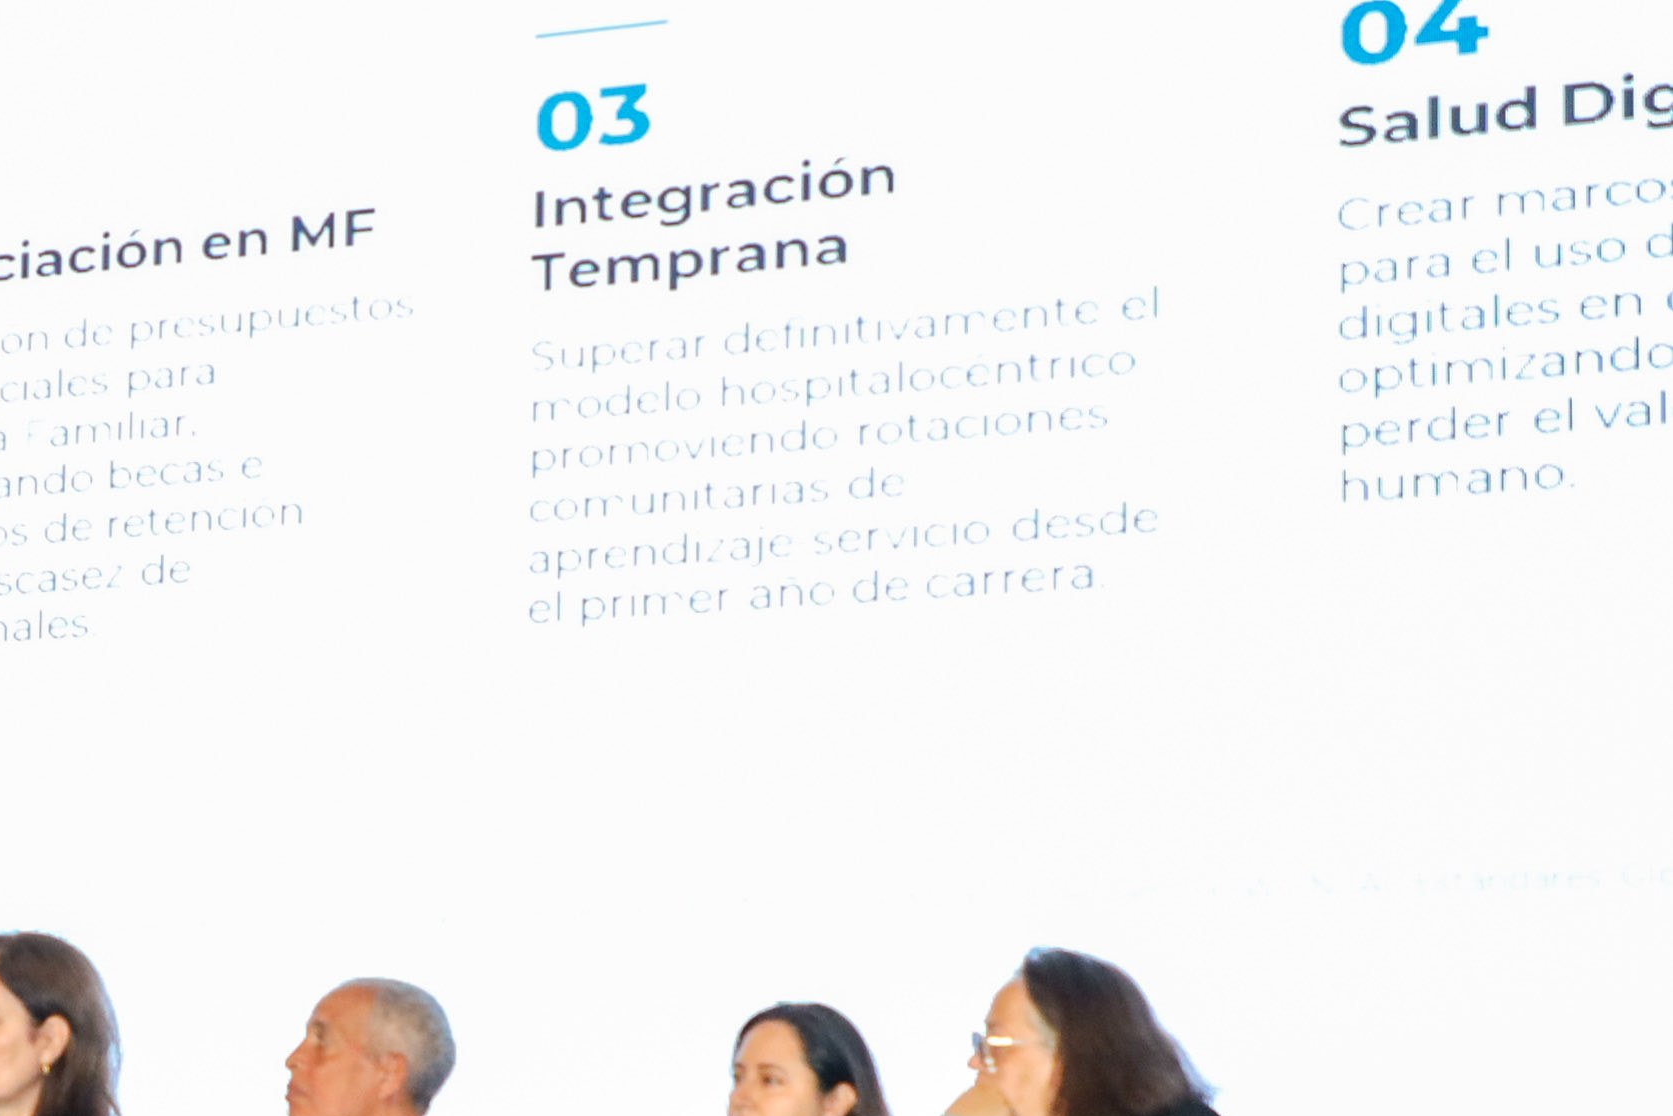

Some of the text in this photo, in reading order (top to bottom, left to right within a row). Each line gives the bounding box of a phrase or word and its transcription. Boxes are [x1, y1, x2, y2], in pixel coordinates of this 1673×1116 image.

[1340, 0, 1492, 67] 04
[535, 82, 652, 152] 03
[1337, 84, 1538, 149] Salud
[534, 156, 896, 229] Integración
[1338, 178, 1673, 231] Crear marco
[201, 227, 268, 262] en
[291, 207, 376, 253] MF
[530, 234, 848, 292] Temprana
[1340, 253, 1451, 295] para
[1472, 236, 1511, 274] el
[1534, 237, 1627, 269] uso
[64, 318, 113, 348] de
[131, 296, 413, 350] presupuestos
[532, 285, 1159, 374] Superar definitivamente el
[1338, 293, 1561, 346] digitales
[1579, 292, 1643, 320] en
[128, 364, 215, 399] para
[1338, 336, 1673, 400] optimizando
[532, 381, 701, 422] modelo
[1341, 389, 1673, 456] perder el val
[532, 408, 1108, 479] promoviendo rotaciones
[110, 460, 224, 489] becas
[241, 457, 262, 479] e
[530, 467, 904, 522] comunitarias de
[1342, 464, 1574, 503] humano.
[44, 513, 92, 543] de
[1012, 501, 1158, 541] desde
[142, 554, 190, 585] de
[529, 591, 561, 623] el
[582, 589, 728, 627] primer
[750, 576, 836, 611] año
[852, 570, 909, 603] de
